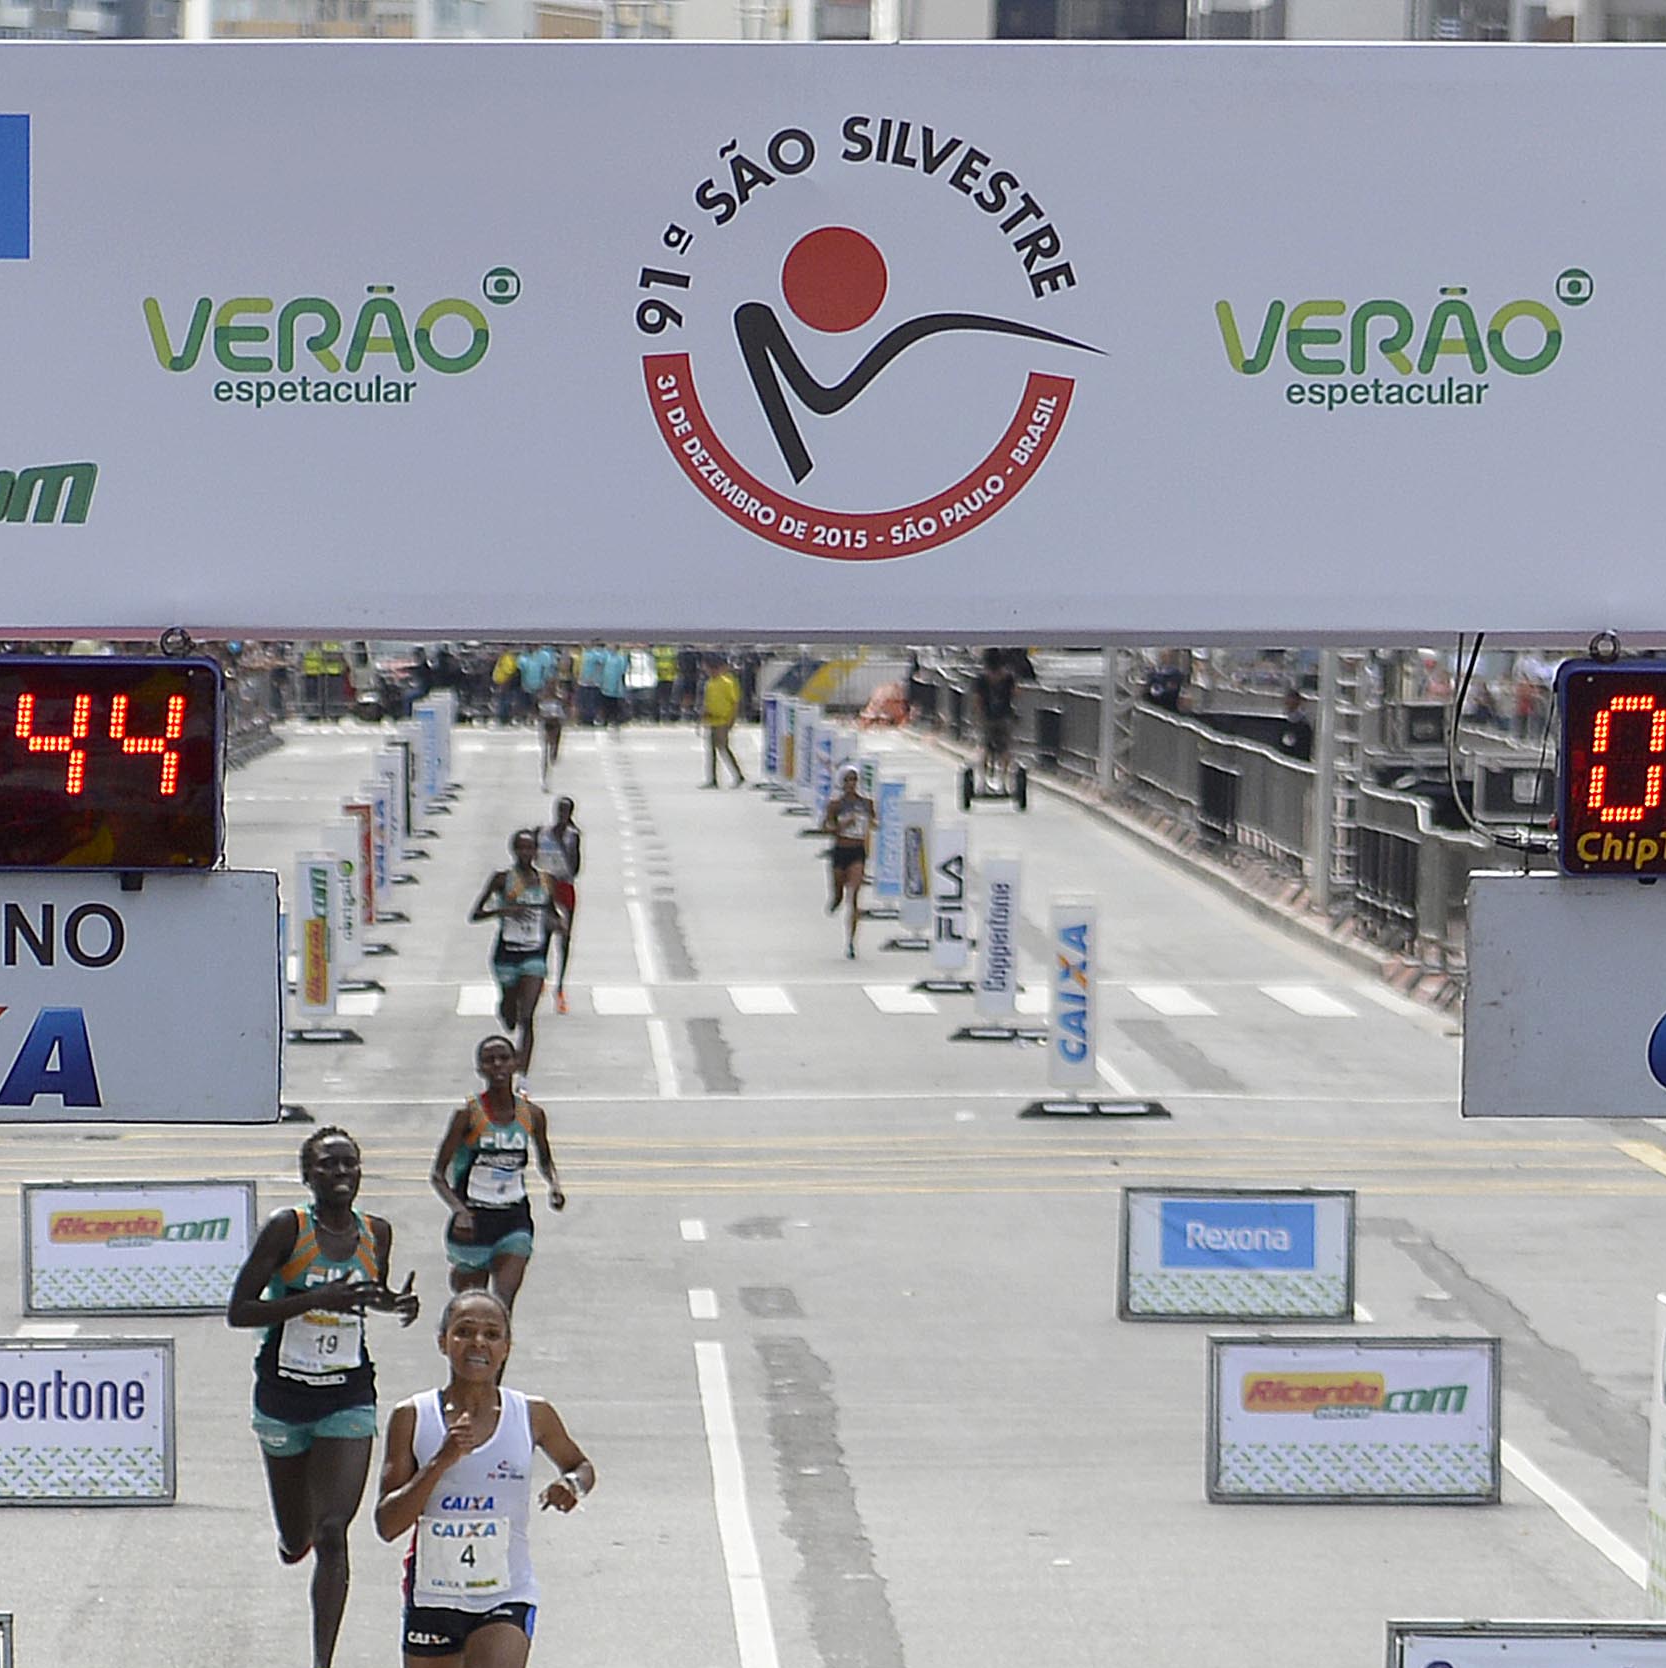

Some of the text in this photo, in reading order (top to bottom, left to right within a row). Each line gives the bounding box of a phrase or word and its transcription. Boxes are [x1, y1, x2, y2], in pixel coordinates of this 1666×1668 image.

[695, 138, 816, 226] SÃO
[841, 115, 1077, 299] SILVESTRE
[143, 284, 489, 374] VERÃO
[1215, 286, 1562, 375] VERÃO
[213, 376, 417, 408] espetacular
[1286, 377, 1488, 410] espetacular
[656, 374, 1058, 549] 31 DE DEZEMBRO DE 2015 SÃO PAULO BRASIL
[937, 854, 965, 943] FILA
[984, 881, 1011, 993] Coppertone
[1061, 923, 1087, 1063] CAIXA
[479, 1132, 525, 1150] FILA
[52, 1216, 160, 1236] Ricardo
[1186, 1222, 1290, 1251] Rexona
[315, 1334, 339, 1355] 19
[1246, 1379, 1379, 1402] Ricardo
[441, 1496, 495, 1511] CAIXA
[432, 1522, 497, 1538] CAIXA
[460, 1544, 476, 1569] 4
